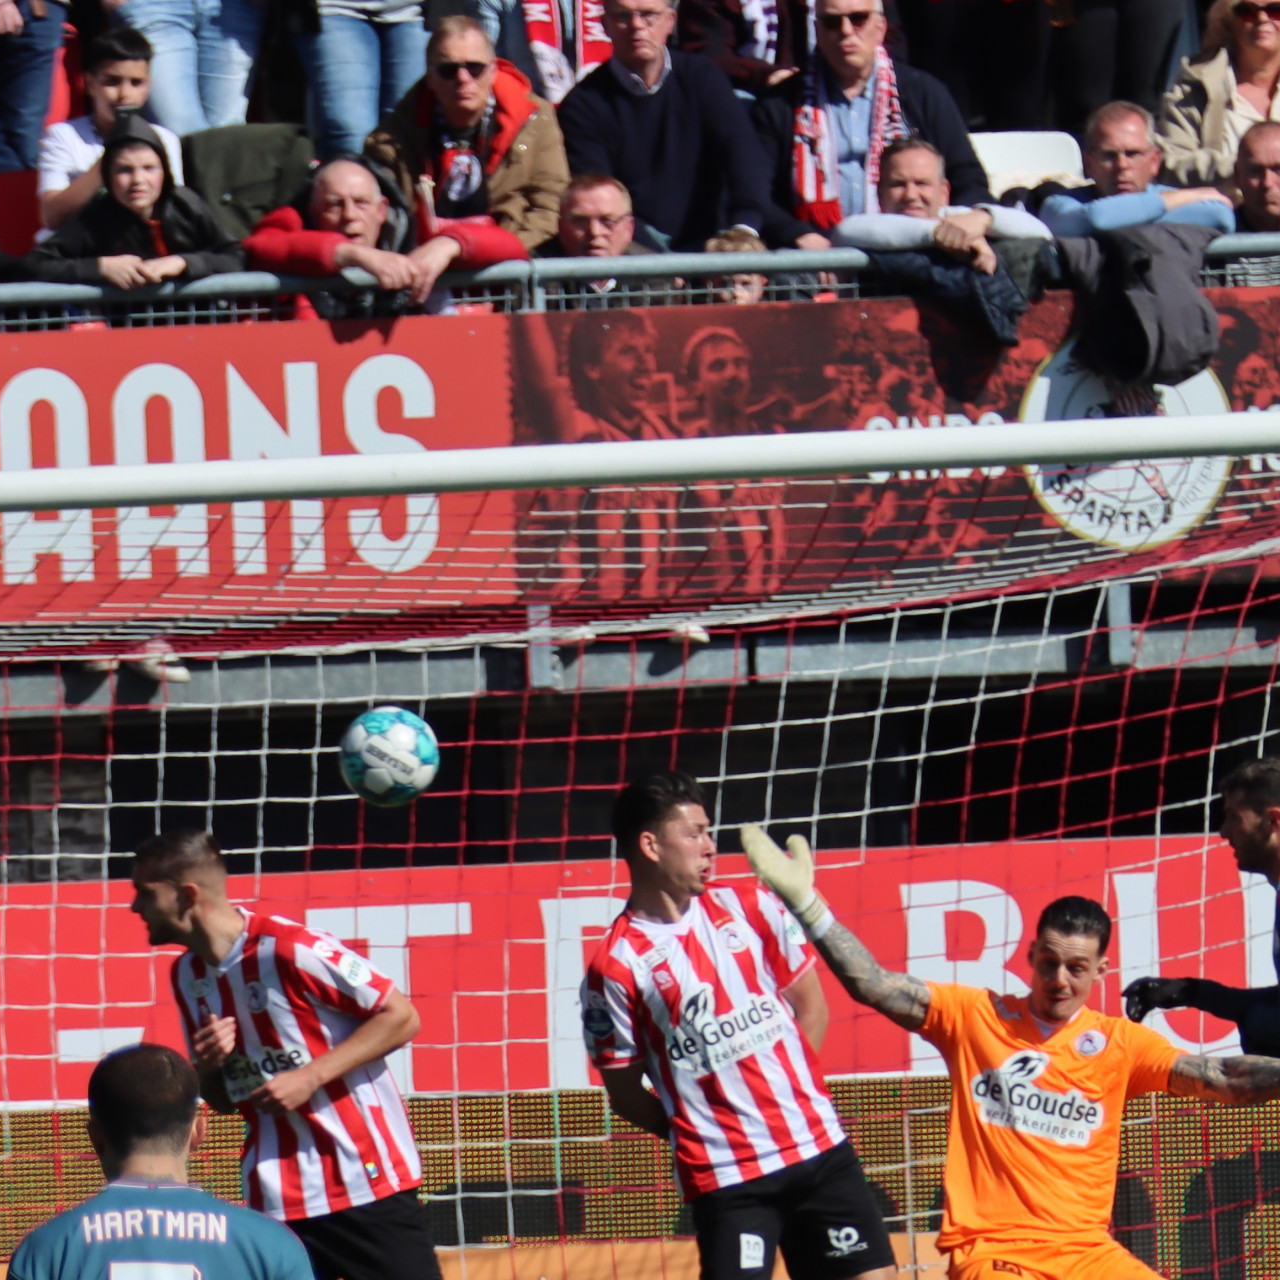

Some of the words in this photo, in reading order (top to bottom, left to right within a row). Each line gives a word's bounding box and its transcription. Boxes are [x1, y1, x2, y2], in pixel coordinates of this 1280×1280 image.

[1050, 472, 1156, 534] SPARTA
[671, 1036, 696, 1061] de
[974, 1074, 1002, 1102] de
[1008, 1083, 1097, 1124] Goudse
[83, 1209, 227, 1243] HARTMAN
